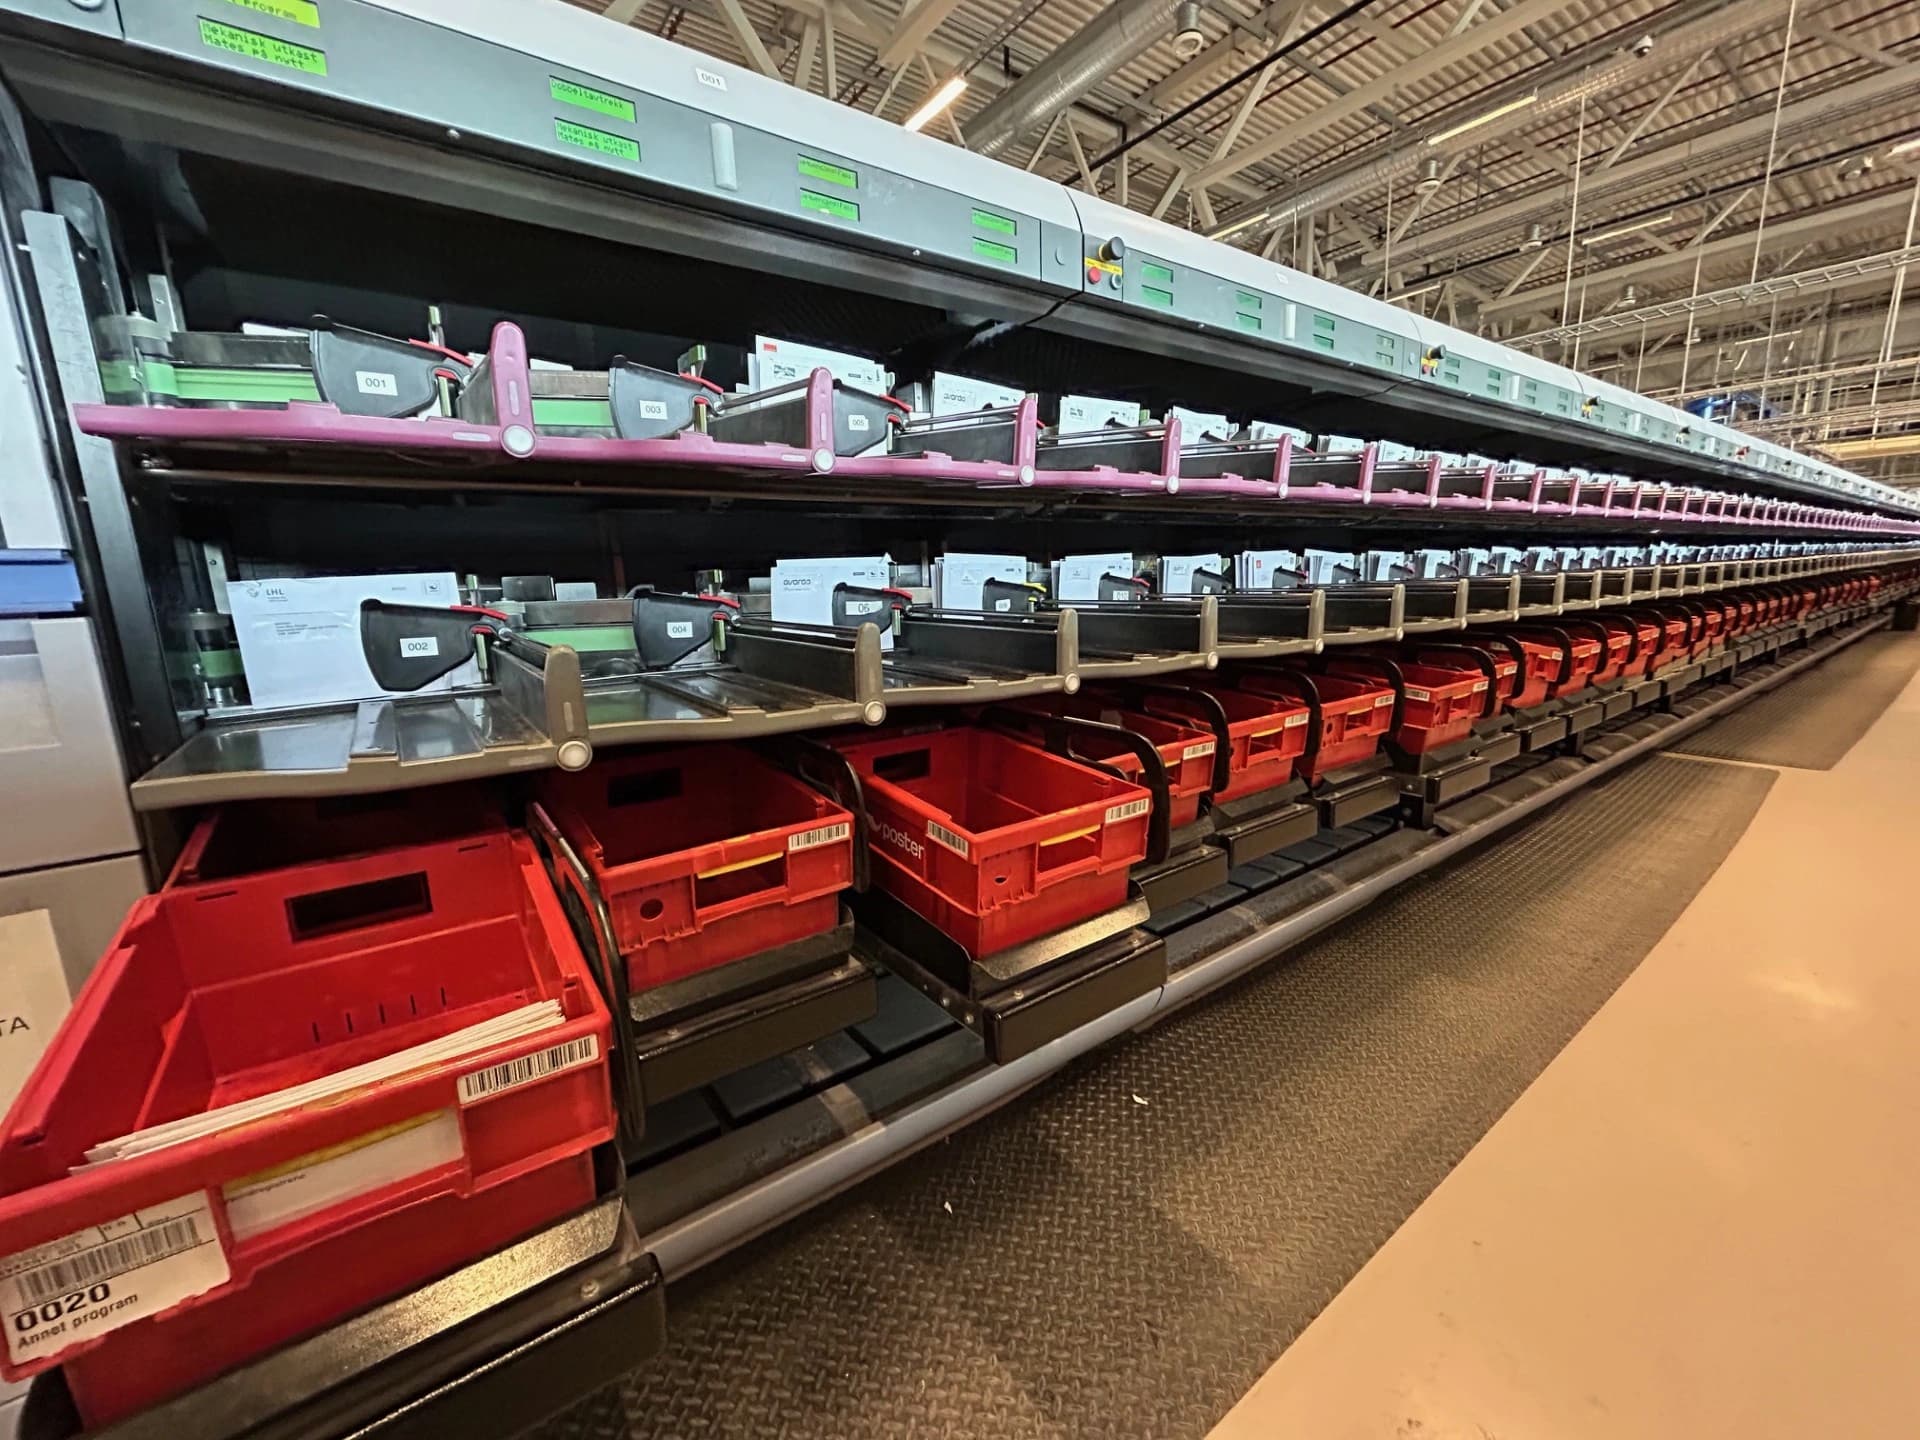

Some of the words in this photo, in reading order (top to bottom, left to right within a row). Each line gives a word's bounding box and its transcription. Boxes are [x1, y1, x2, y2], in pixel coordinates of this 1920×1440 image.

[202, 22, 265, 47] Mekanisk
[272, 43, 319, 63] utkast
[204, 33, 245, 53] Mates
[701, 72, 721, 86] 001
[365, 377, 386, 388] 001
[645, 404, 662, 414] 003
[852, 417, 865, 427] 005
[266, 588, 285, 596] LHL
[672, 625, 687, 633] 004
[407, 642, 429, 651] 002
[14, 1282, 110, 1332] 0020
[17, 1321, 66, 1350] Annet
[71, 1294, 138, 1329] program
